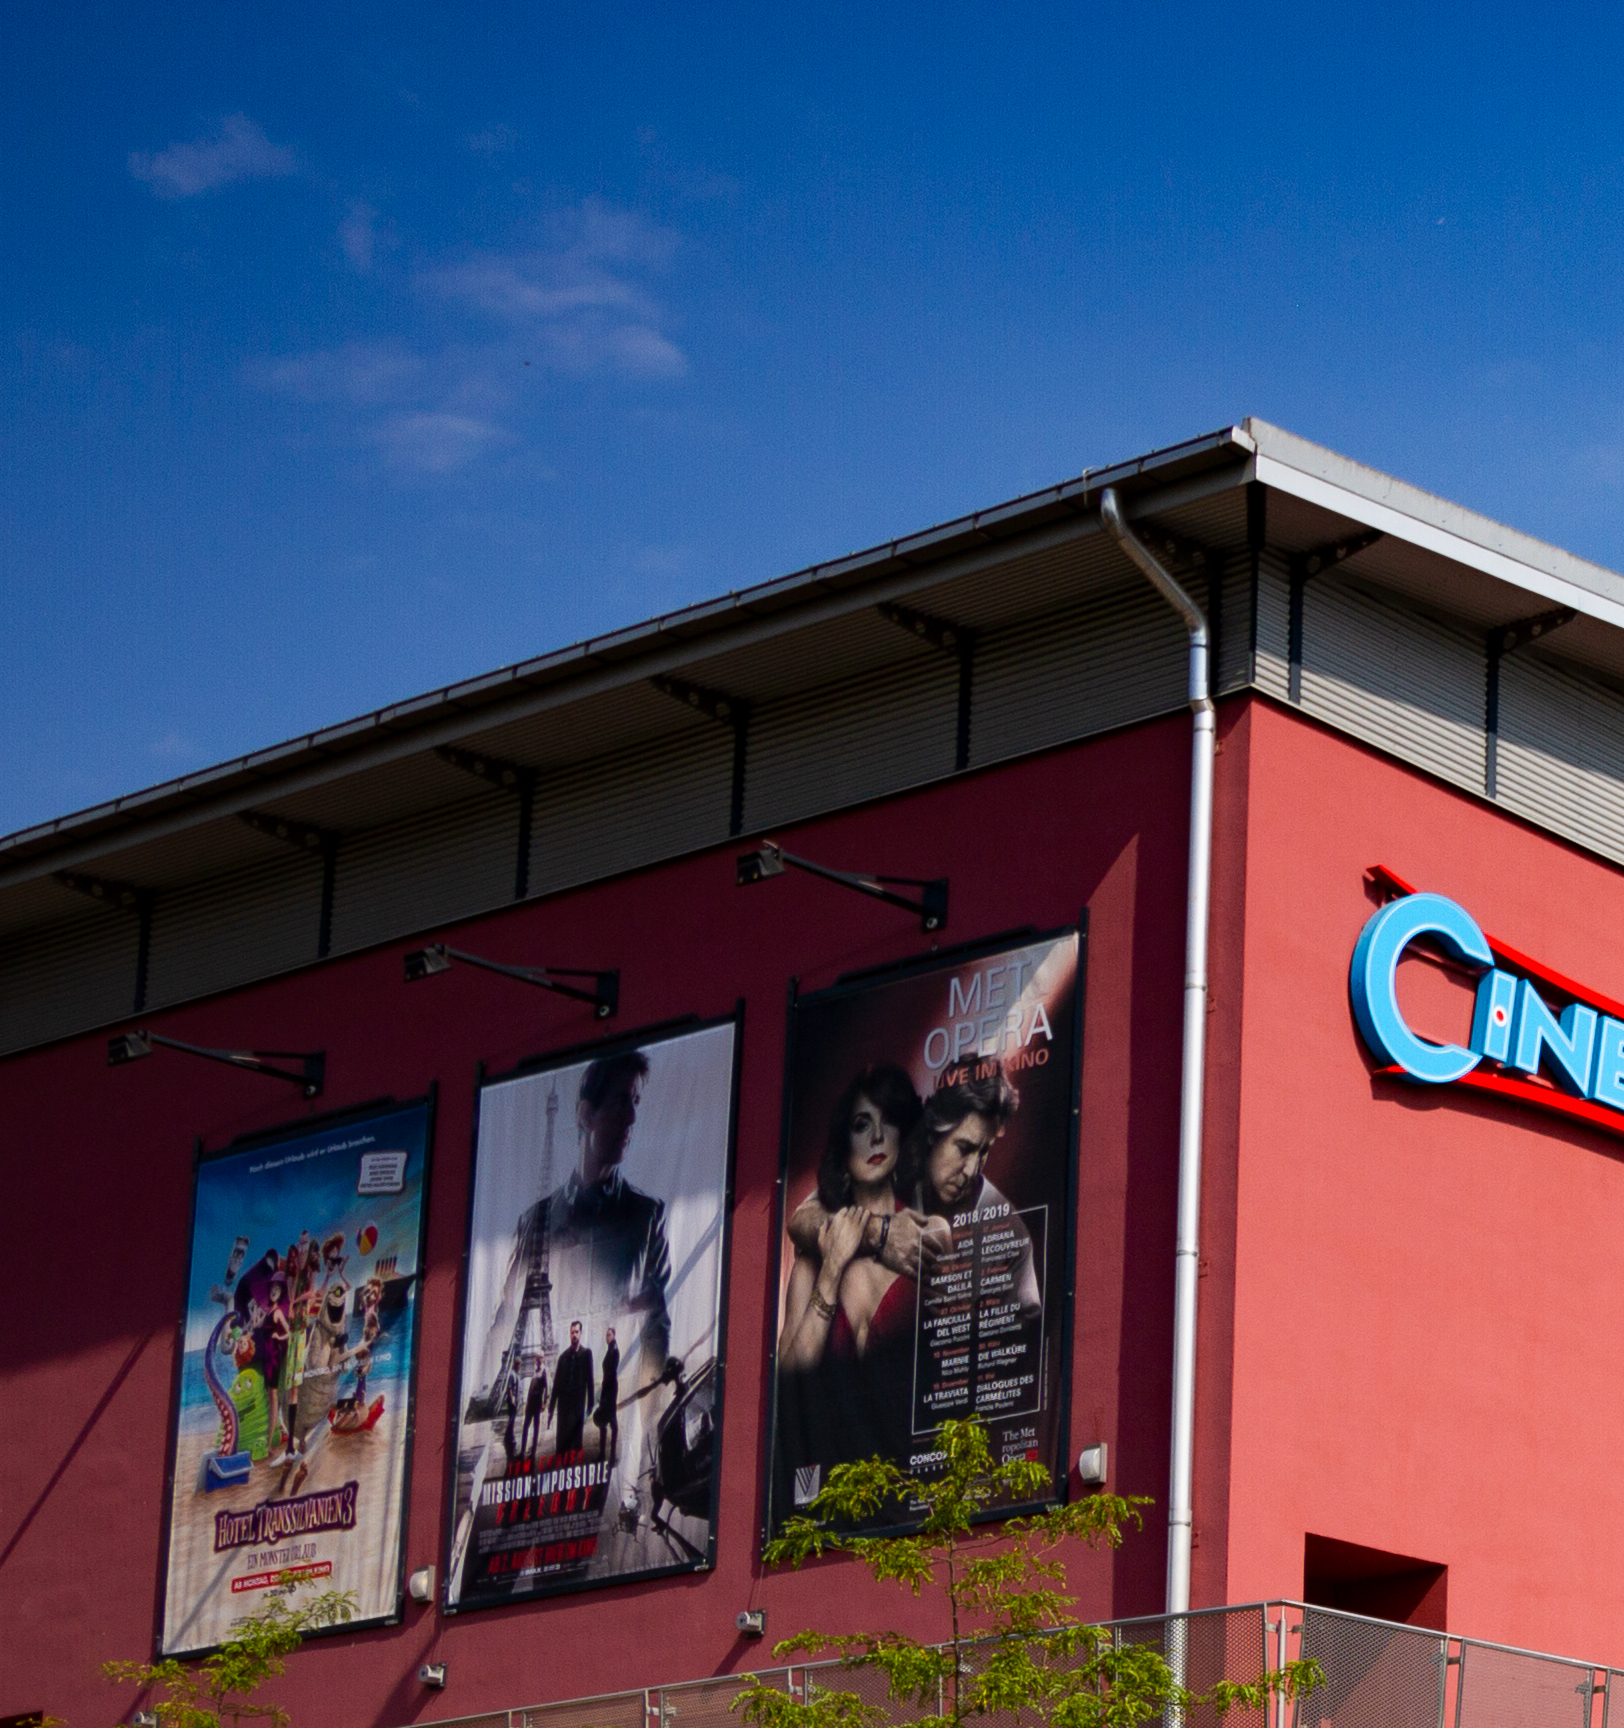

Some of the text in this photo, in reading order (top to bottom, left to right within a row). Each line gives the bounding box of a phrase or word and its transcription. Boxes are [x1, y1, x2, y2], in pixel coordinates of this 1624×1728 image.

[948, 959, 1032, 1017] MET
[924, 1002, 1053, 1069] OPERA
[934, 1049, 1049, 1090] LIVE IM KINO
[953, 1203, 1010, 1228] 2018/2019
[979, 1308, 990, 1318] LA
[924, 1320, 933, 1330] LA
[937, 1327, 950, 1337] DEL
[1019, 1374, 1034, 1385] DES
[923, 1394, 933, 1403] LA
[1002, 1427, 1036, 1442] The Met
[218, 1487, 353, 1548] HOTEL TRANSSILVANIEN 3
